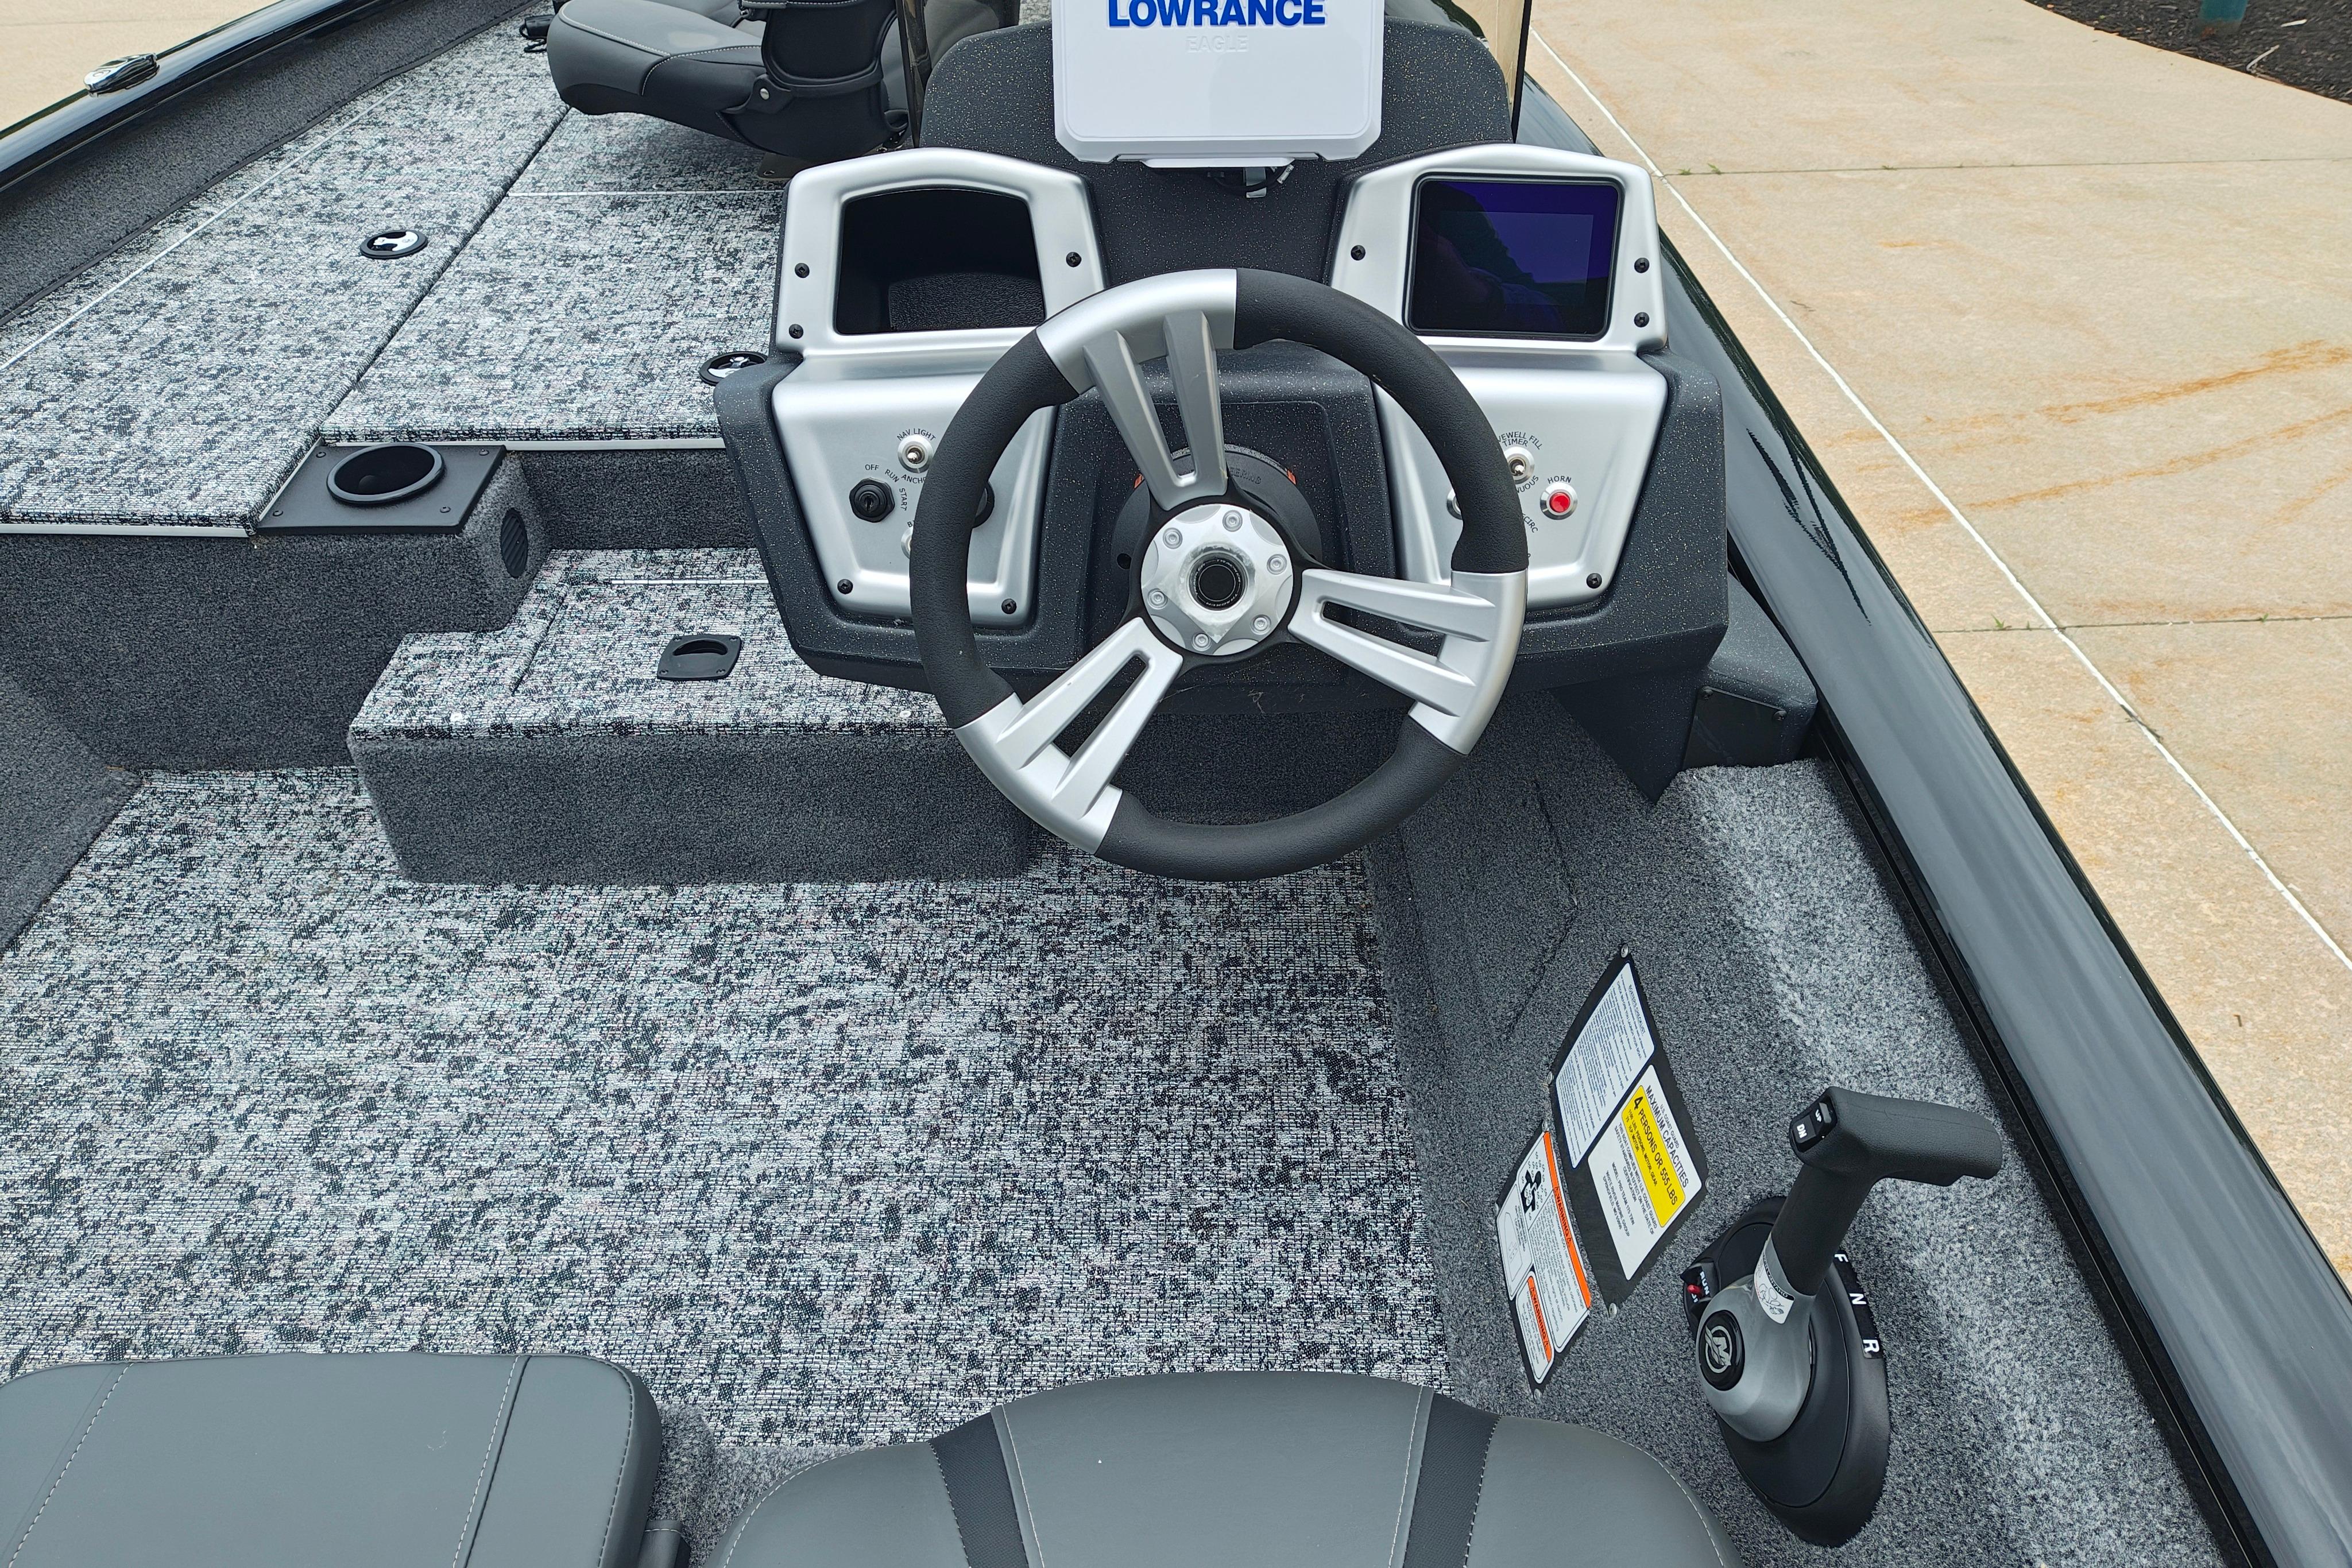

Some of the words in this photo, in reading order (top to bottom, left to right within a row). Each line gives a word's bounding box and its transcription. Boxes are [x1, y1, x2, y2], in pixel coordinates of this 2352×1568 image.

[1108, 0, 1325, 26] LOWRANCE
[1187, 35, 1249, 52] EAGLE
[897, 429, 911, 440] NAV
[914, 428, 936, 441] LIGHT
[1498, 431, 1526, 442] VEWELL
[1529, 435, 1542, 450] FILL
[1502, 438, 1528, 447] TIMER
[885, 469, 899, 482] RUN
[1229, 467, 1261, 484] EERING
[1548, 475, 1572, 484] HORN
[899, 488, 907, 510] START
[1522, 513, 1538, 533] CIRC
[1634, 1096, 1643, 1110] 4
[1816, 1109, 1821, 1122] UP
[1638, 1108, 1657, 1153] PERSONS
[1646, 1085, 1665, 1131] MAXIMUM
[1662, 1130, 1688, 1188] CAPACITIES
[1664, 1114, 1672, 1130] COAST
[1670, 1130, 1679, 1148] GUARD
[1797, 1124, 1807, 1138] DN
[1654, 1152, 1663, 1169] OR
[1620, 1143, 1631, 1172] STANDARDS
[1631, 1176, 1640, 1196] EFFECT
[1638, 1195, 1643, 1204] ON
[1660, 1167, 1670, 1186] 555
[1623, 1166, 1637, 1202] CERTIFICATION
[1627, 1147, 1637, 1171] COMPLIES
[1643, 1193, 1651, 1210] COAST
[1649, 1210, 1657, 1229] GUARD
[1666, 1183, 1677, 1205] LBS
[1556, 1193, 1569, 1237] WARNING
[1835, 1254, 1848, 1263] F
[1700, 1271, 1709, 1295] RUN
[1850, 1293, 1866, 1304] N
[1532, 1294, 1546, 1340] WARNING
[1863, 1339, 1879, 1352] R
